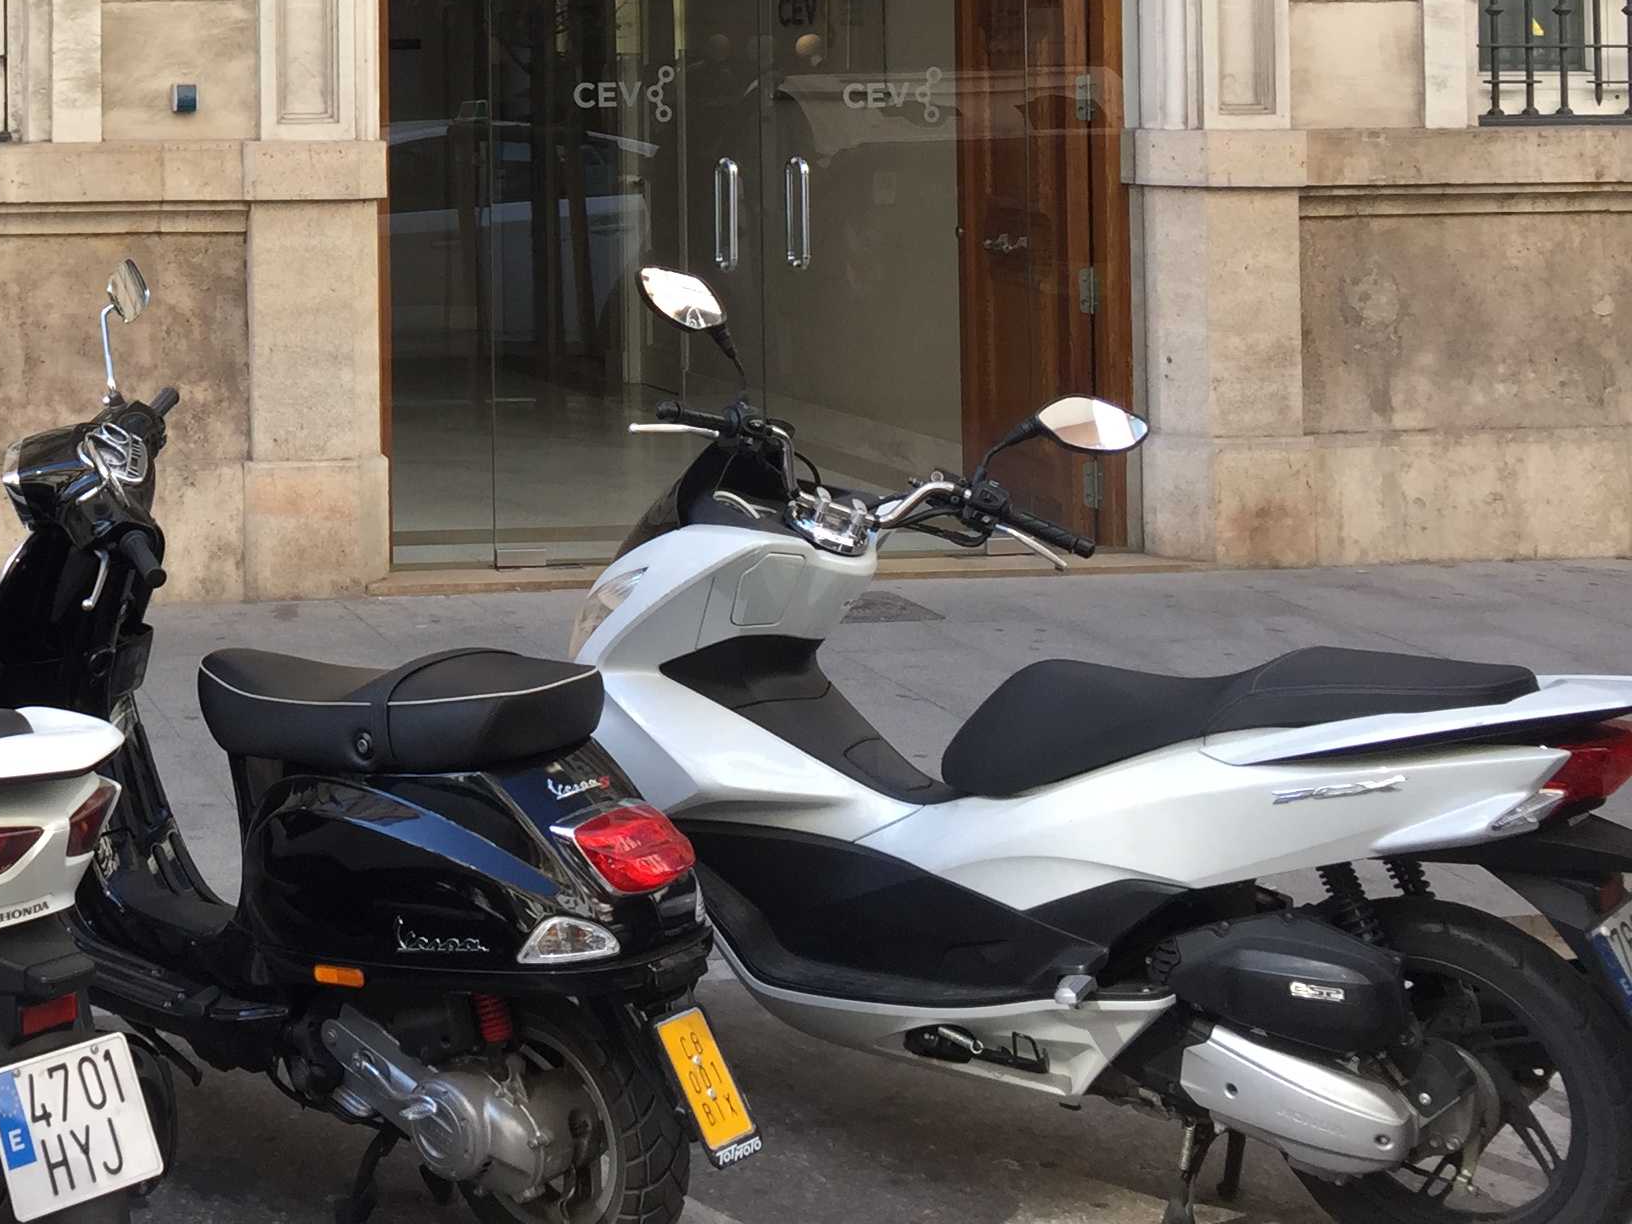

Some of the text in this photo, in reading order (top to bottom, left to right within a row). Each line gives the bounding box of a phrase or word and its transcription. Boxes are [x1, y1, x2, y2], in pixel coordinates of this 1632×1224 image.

[573, 81, 642, 109] CEV
[842, 82, 910, 109] CEV
[394, 915, 490, 953] Vespa
[28, 1049, 126, 1128] 4701
[8, 1128, 26, 1153] E
[41, 1117, 124, 1196] HYJ
